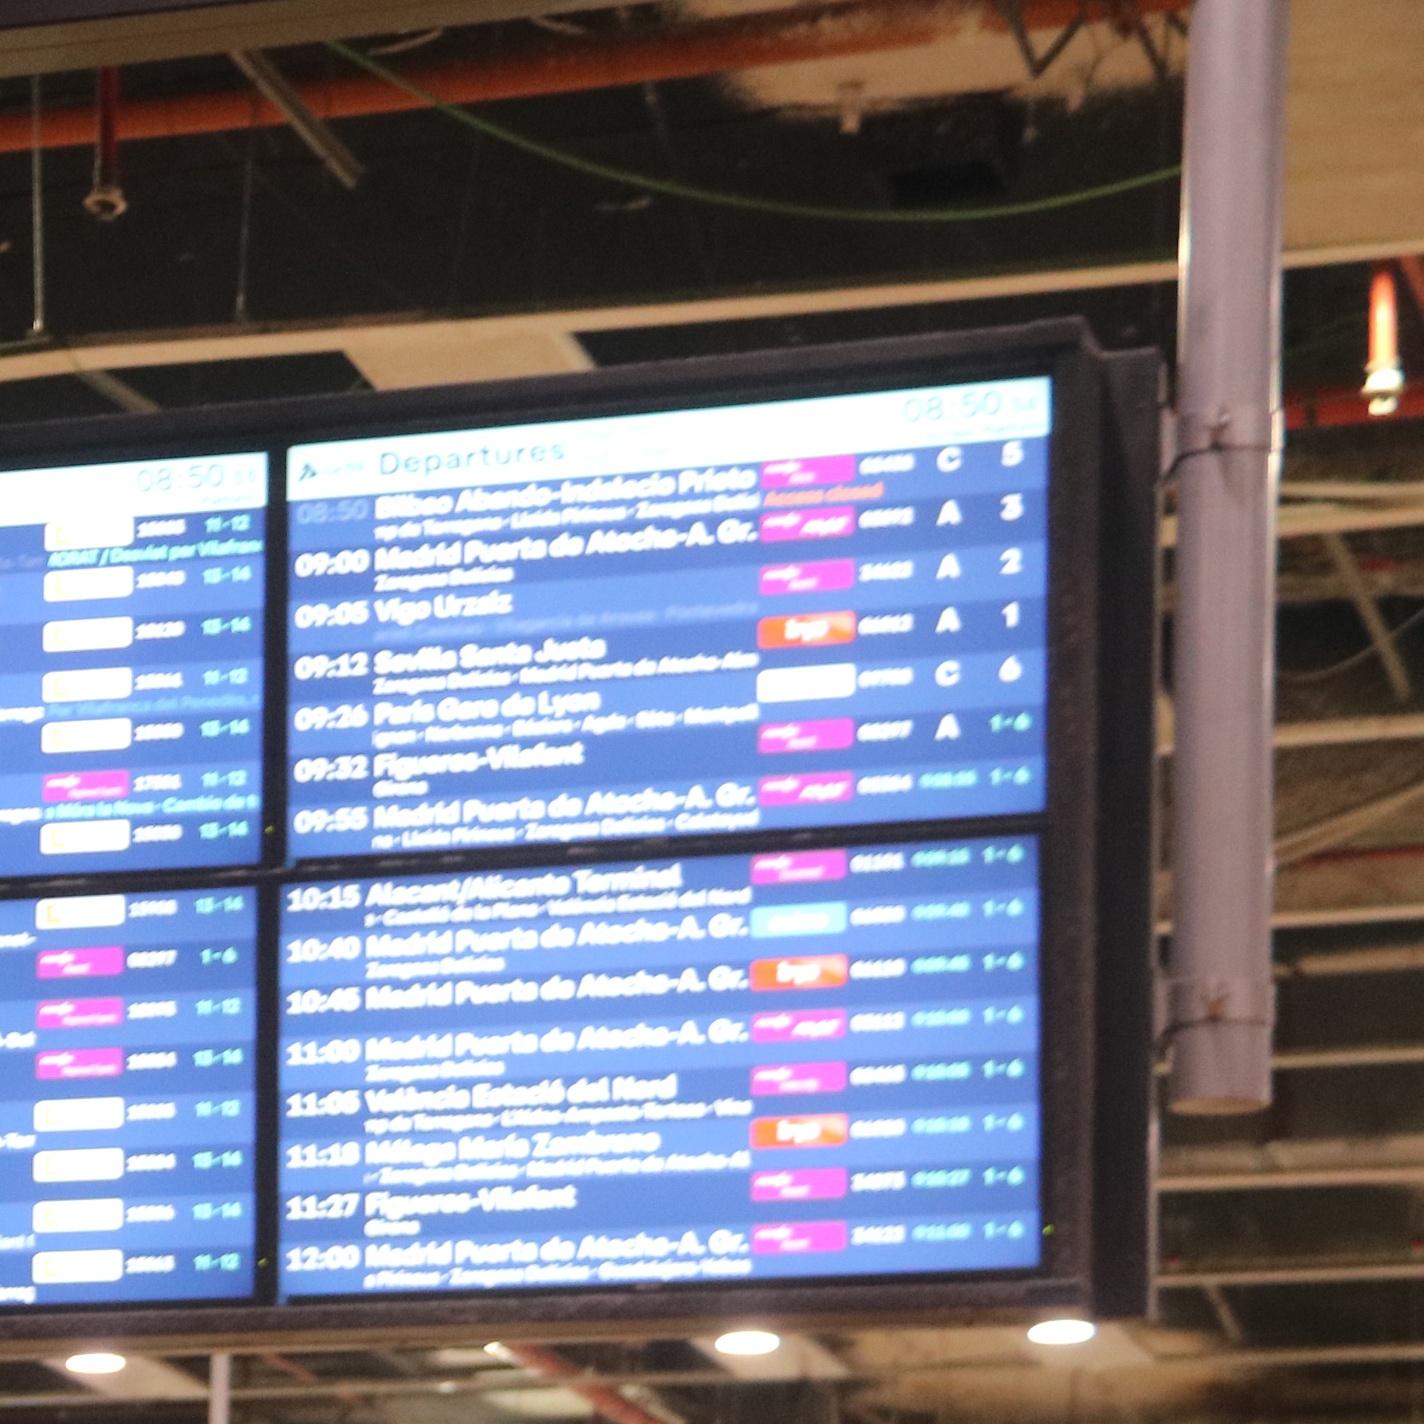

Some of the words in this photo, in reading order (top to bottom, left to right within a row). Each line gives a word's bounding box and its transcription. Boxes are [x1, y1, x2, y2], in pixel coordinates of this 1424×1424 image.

[375, 494, 452, 519] Bilbao
[452, 473, 676, 512] Abando-Indalecio
[679, 468, 756, 493] Prieto
[937, 447, 961, 472] C
[1002, 441, 1023, 466] 5
[379, 442, 565, 477] Departures
[295, 550, 370, 577] 09:00
[375, 541, 461, 570] Madrid
[464, 537, 547, 563] Puerta
[547, 533, 584, 557] de
[937, 501, 961, 525] A
[1001, 494, 1022, 520] 3
[295, 601, 369, 628] 09:05
[374, 598, 432, 625] Vigo
[434, 590, 512, 618] Urzaiz
[937, 554, 960, 578] A
[1001, 549, 1021, 574] 2
[295, 652, 368, 679] 09:12
[374, 646, 457, 674] Sevilla
[459, 642, 531, 668] Santa
[531, 637, 606, 663] Justa
[936, 608, 960, 632] A
[1002, 602, 1018, 627] 1
[295, 704, 368, 730] 09:26
[438, 697, 497, 721] Gare
[498, 693, 536, 717] de
[538, 691, 601, 717] Lyon
[935, 661, 960, 686] C
[999, 657, 1021, 681] 6
[294, 755, 368, 782] 09:32
[374, 742, 584, 779] Figueres-Vilafant
[935, 714, 959, 739] A
[288, 885, 361, 911] 10:15
[365, 874, 568, 906] Alacant/Alicante
[568, 864, 682, 893] Terminal
[365, 1139, 457, 1166] Málaga
[532, 1130, 661, 1157] Zambrano
[287, 1245, 360, 1270] 12:00
[365, 1241, 452, 1267] Madrid
[455, 1239, 540, 1263] Puerta
[540, 1236, 576, 1260] de
